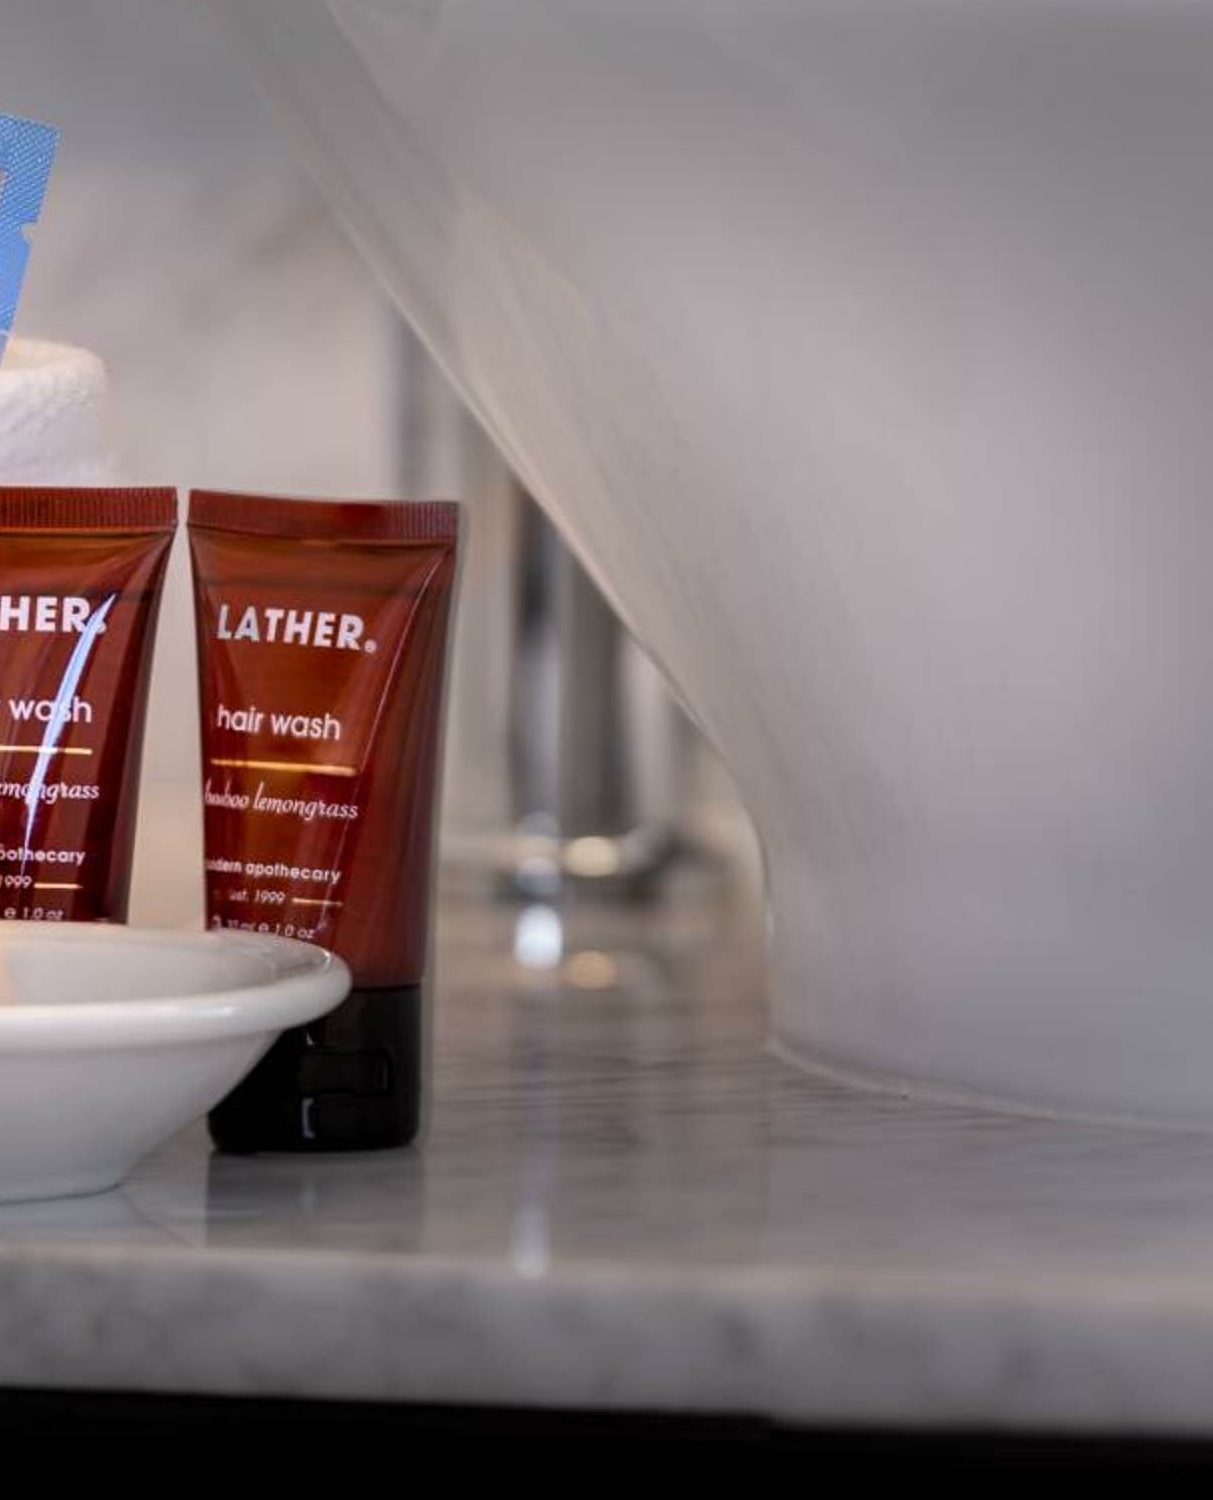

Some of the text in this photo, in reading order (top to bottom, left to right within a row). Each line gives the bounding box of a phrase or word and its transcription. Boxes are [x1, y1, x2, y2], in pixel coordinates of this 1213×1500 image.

[10, 695, 93, 724] wash
[216, 703, 342, 741] hair wash
[253, 781, 359, 821] lemongrass
[245, 862, 342, 885] apothecary
[254, 889, 287, 905] 1999
